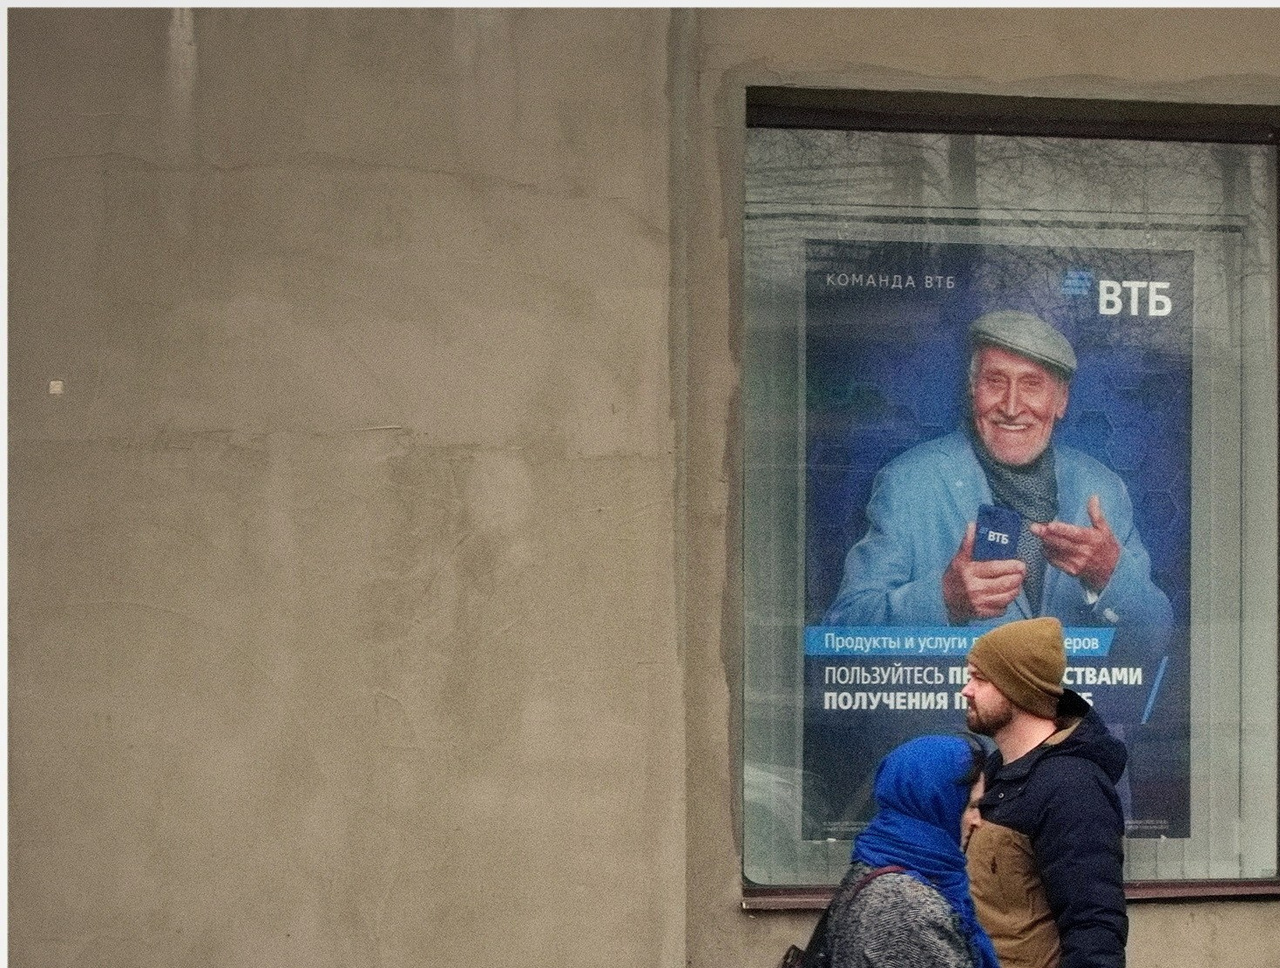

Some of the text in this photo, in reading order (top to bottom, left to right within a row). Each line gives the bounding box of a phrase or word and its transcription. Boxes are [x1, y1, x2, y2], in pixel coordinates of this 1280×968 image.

[826, 273, 955, 289] КОМАНДА ВТБ
[1099, 280, 1172, 316] ВТБ
[988, 530, 1009, 545] ВТБ
[825, 633, 899, 650] Продукты
[905, 637, 914, 648] и
[919, 637, 967, 652] услуги
[825, 663, 944, 684] ПОЛЬЗУЙТЕСЬ
[824, 692, 948, 710] ПОЛУЧЕНИЯ
